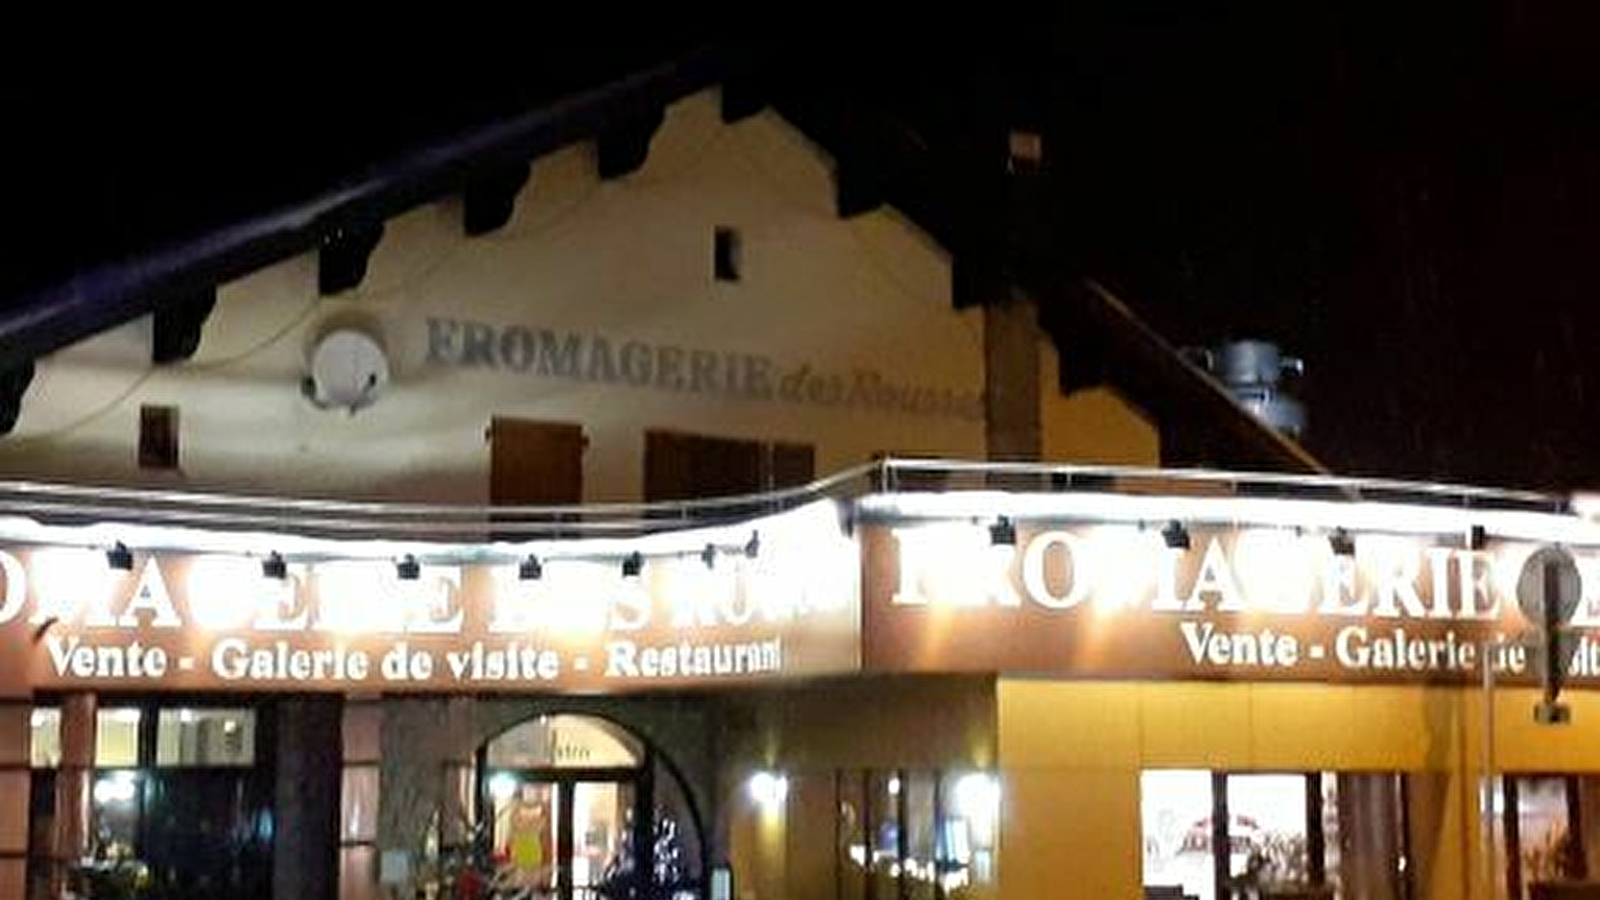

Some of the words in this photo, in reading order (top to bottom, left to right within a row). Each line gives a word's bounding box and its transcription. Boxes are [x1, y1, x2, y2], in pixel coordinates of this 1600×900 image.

[425, 316, 775, 400] FROMAGERIE
[46, 635, 167, 678] Vente
[212, 638, 368, 680] Galerie
[382, 641, 433, 679] de
[448, 641, 559, 681] visite
[1178, 622, 1297, 670] Vente
[1336, 625, 1476, 671] Galerie
